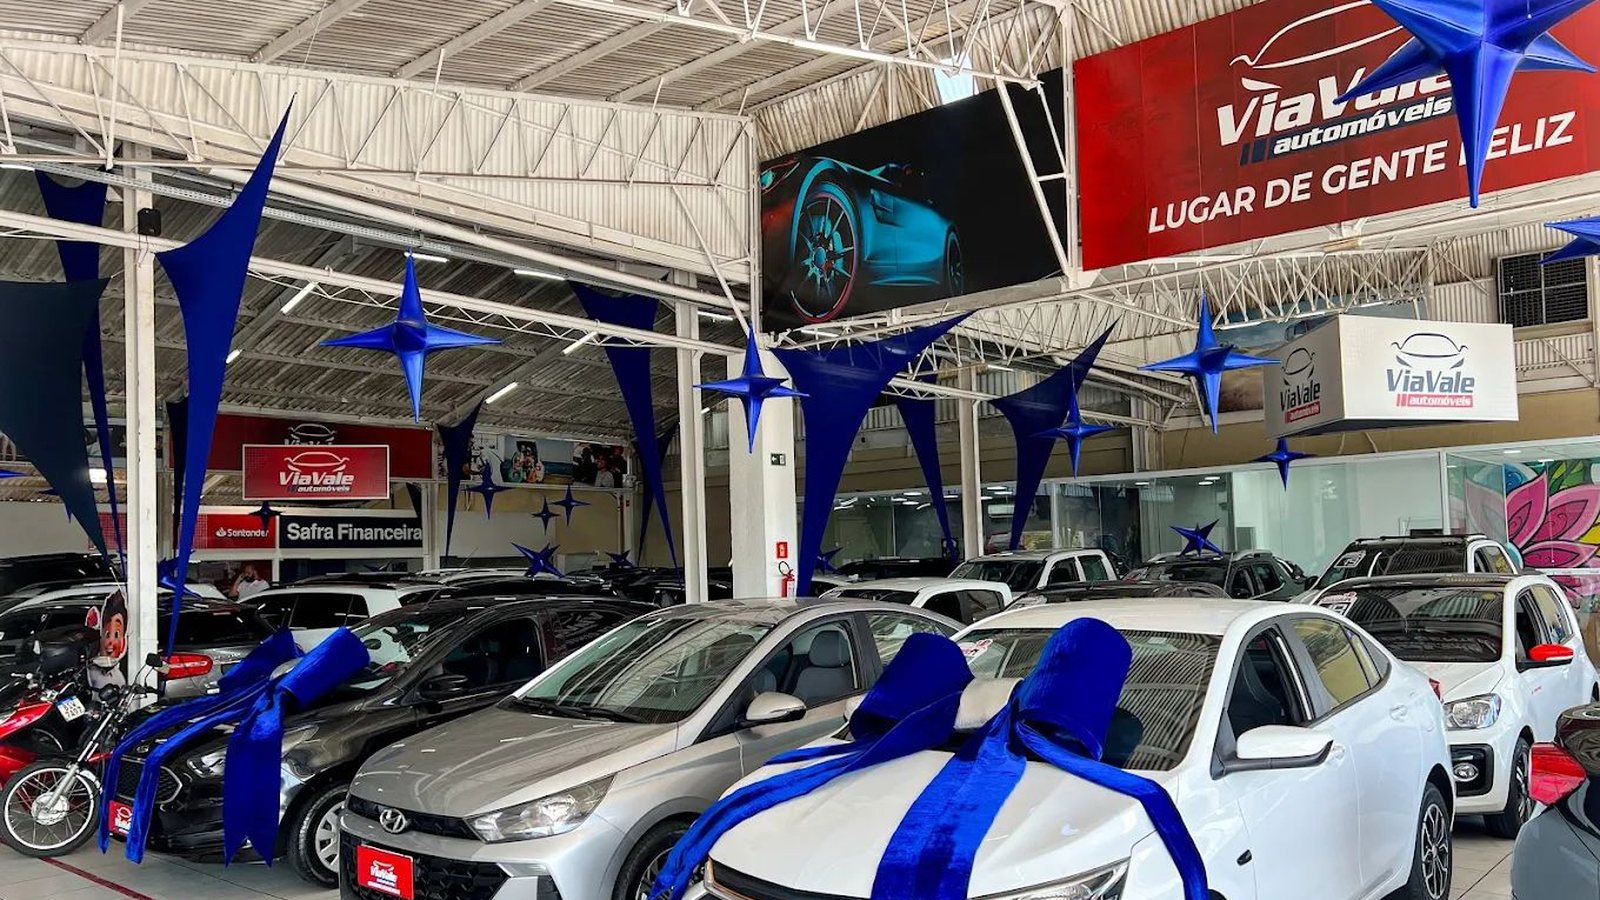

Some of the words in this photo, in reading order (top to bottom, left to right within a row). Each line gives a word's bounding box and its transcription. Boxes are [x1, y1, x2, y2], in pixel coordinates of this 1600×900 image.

[1273, 96, 1453, 155] automóveis
[1148, 185, 1256, 233] LUGAR
[1264, 171, 1312, 209] DE
[1321, 140, 1449, 193] GENTE
[1386, 369, 1475, 393] ViaVale
[1280, 380, 1320, 411] ViaVale
[279, 471, 355, 486] ViaVale
[227, 528, 269, 538] Santander
[287, 522, 334, 541] Safra
[337, 523, 423, 541] Financeira
